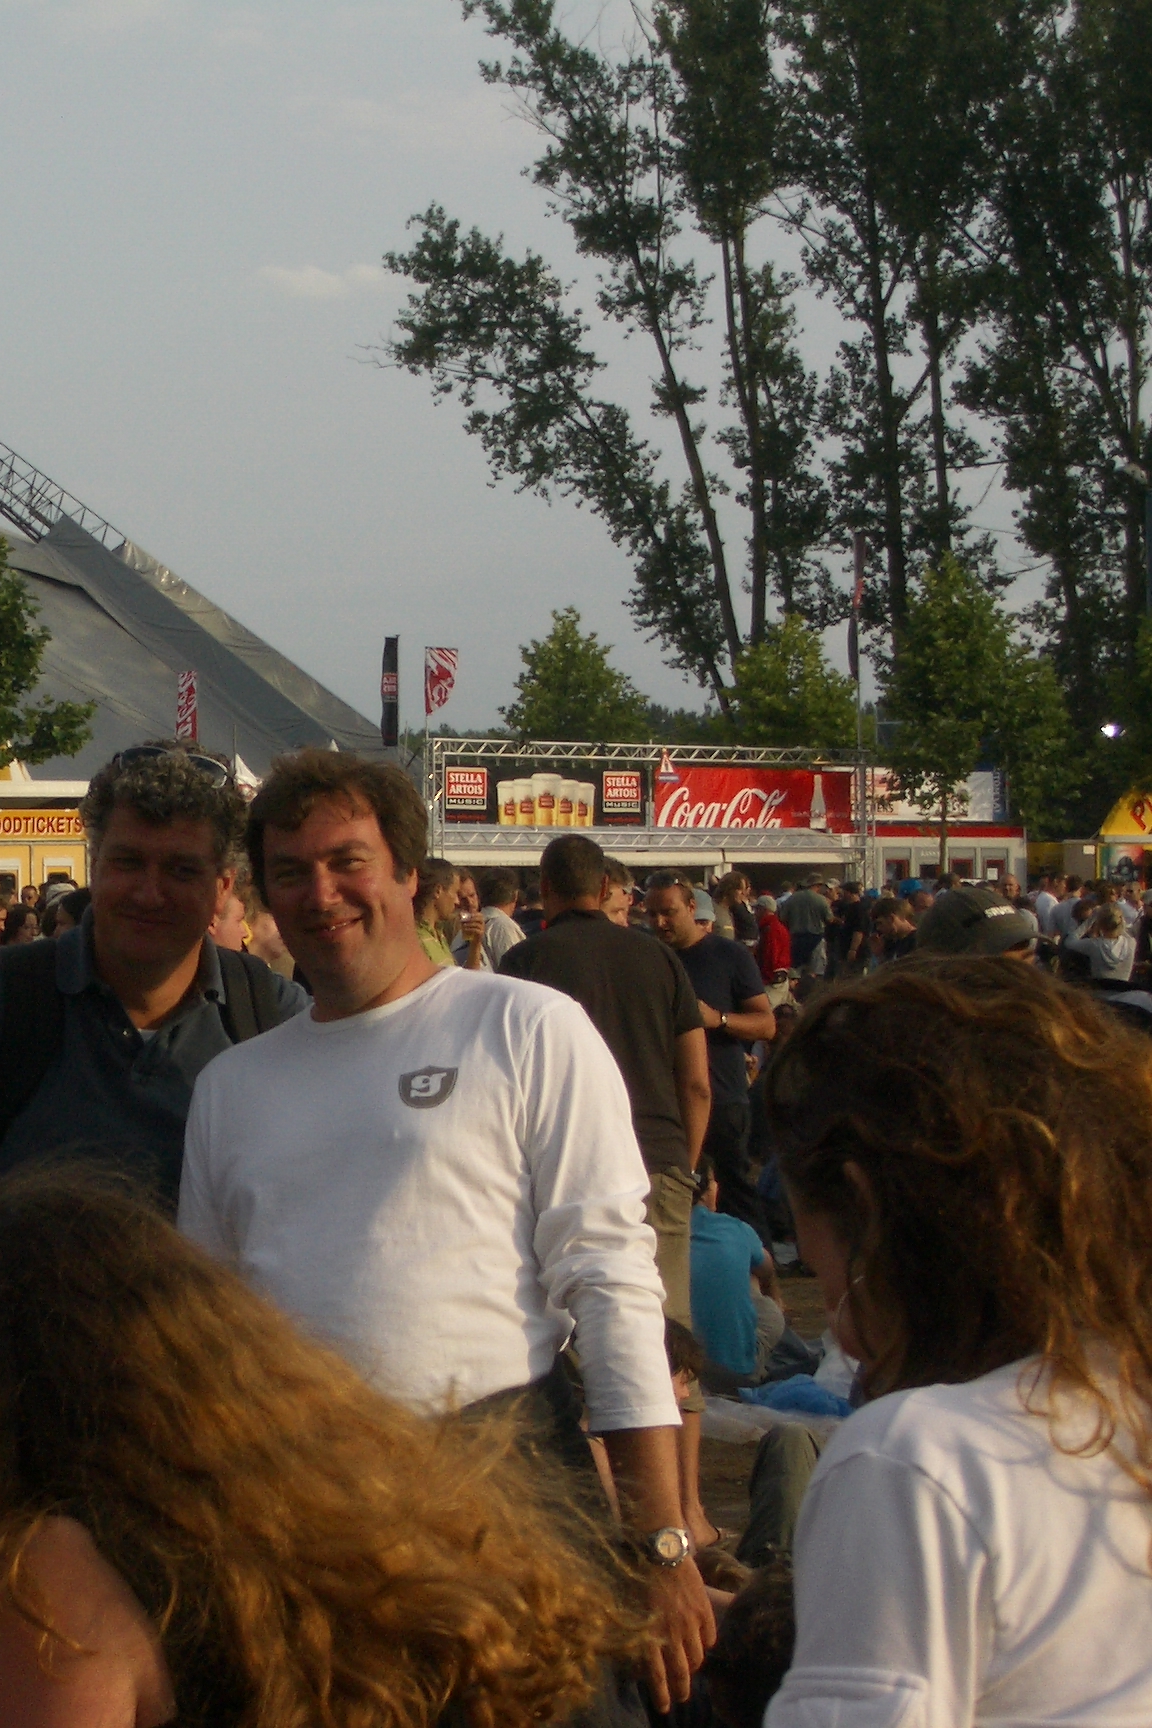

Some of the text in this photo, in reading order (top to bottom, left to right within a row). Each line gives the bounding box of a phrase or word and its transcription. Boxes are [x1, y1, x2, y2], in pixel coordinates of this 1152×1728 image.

[449, 772, 483, 783] STELLA
[606, 776, 637, 787] STELLA
[449, 784, 483, 795] ARTOIS
[606, 788, 637, 799] ARTOIS
